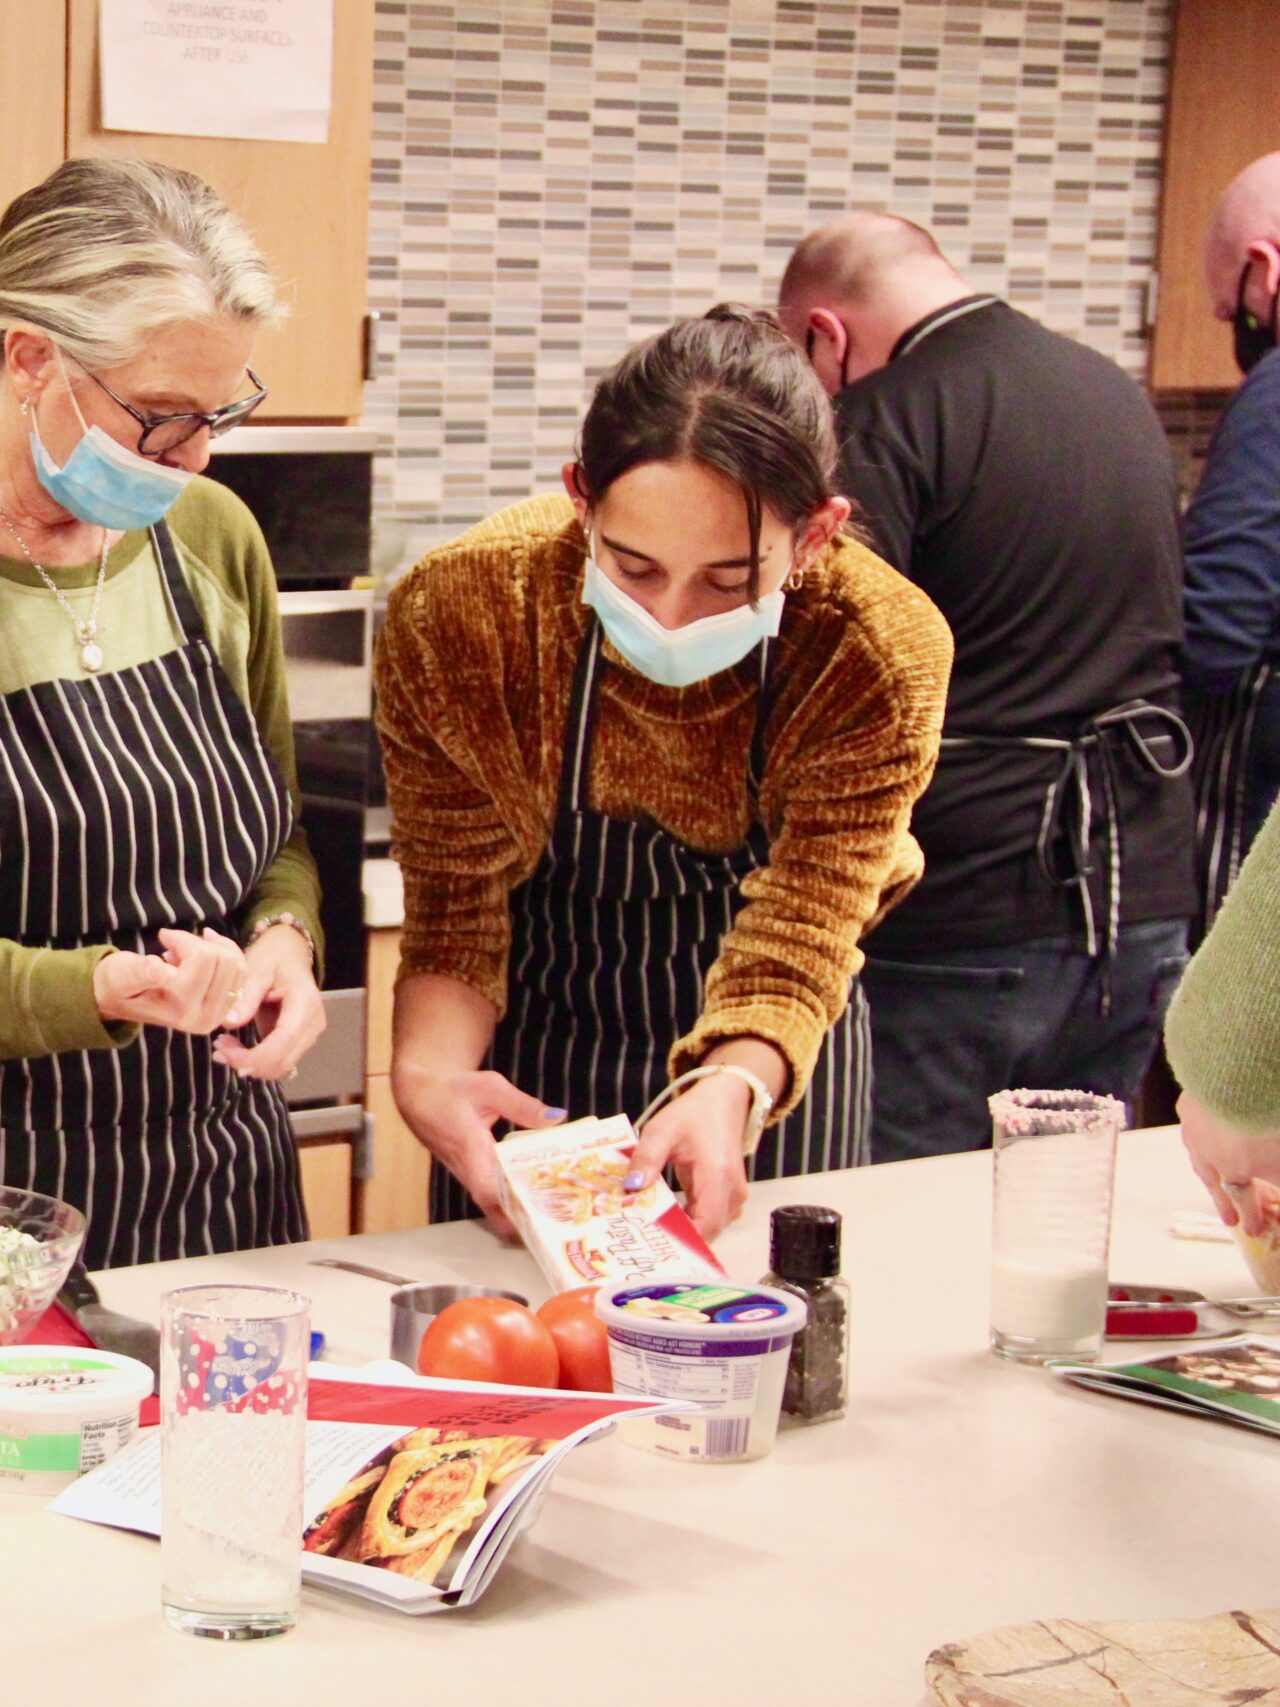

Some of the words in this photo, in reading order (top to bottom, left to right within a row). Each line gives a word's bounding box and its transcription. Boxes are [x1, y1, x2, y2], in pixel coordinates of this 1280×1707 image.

[169, 2, 236, 21] APPLIANCE
[239, 8, 268, 23] AND
[143, 20, 226, 41] COUNTERTOP
[230, 28, 293, 46] SURFACES
[184, 46, 221, 62] AFTER
[226, 48, 250, 64] USE
[605, 1211, 646, 1256] Pastry
[640, 1222, 681, 1263] SHEETS
[15, 1375, 96, 1388] Frigo
[84, 1421, 118, 1431] Nutrition
[83, 1432, 106, 1440] Facts
